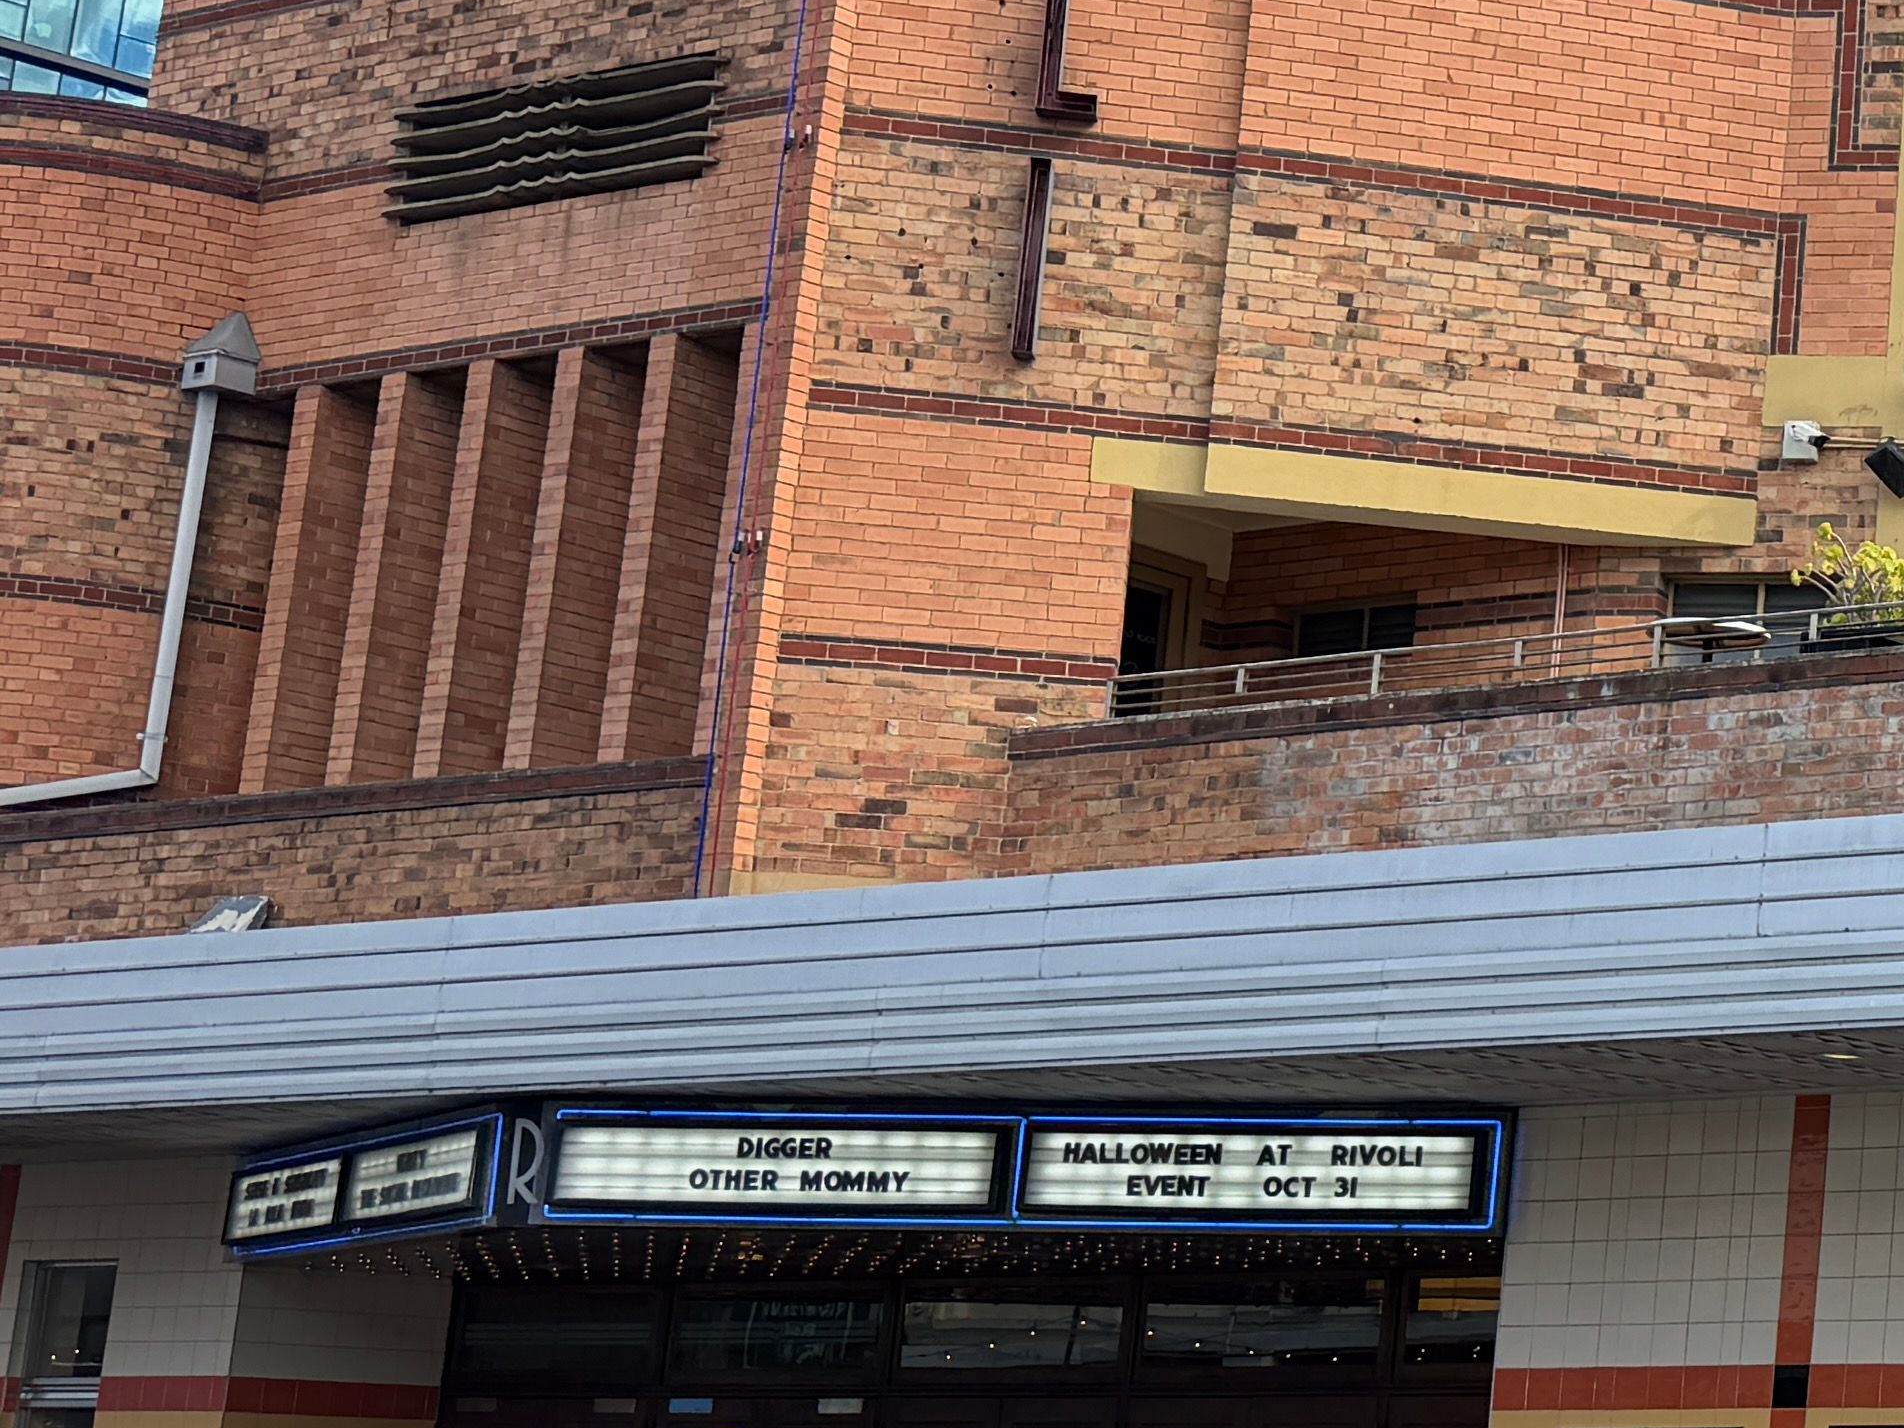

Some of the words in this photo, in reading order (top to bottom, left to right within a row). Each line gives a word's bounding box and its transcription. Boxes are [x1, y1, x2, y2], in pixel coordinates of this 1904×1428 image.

[736, 1137, 832, 1160] DIGGER
[1063, 1142, 1223, 1166] HALLOWEEN
[1256, 1144, 1293, 1167] AT
[1331, 1145, 1423, 1168] RIVOLI
[689, 1168, 778, 1191] OTHER
[799, 1171, 910, 1193] MOMMY
[1126, 1175, 1211, 1198] EVENT
[1263, 1176, 1317, 1198] OCT
[1334, 1175, 1358, 1199] 31
